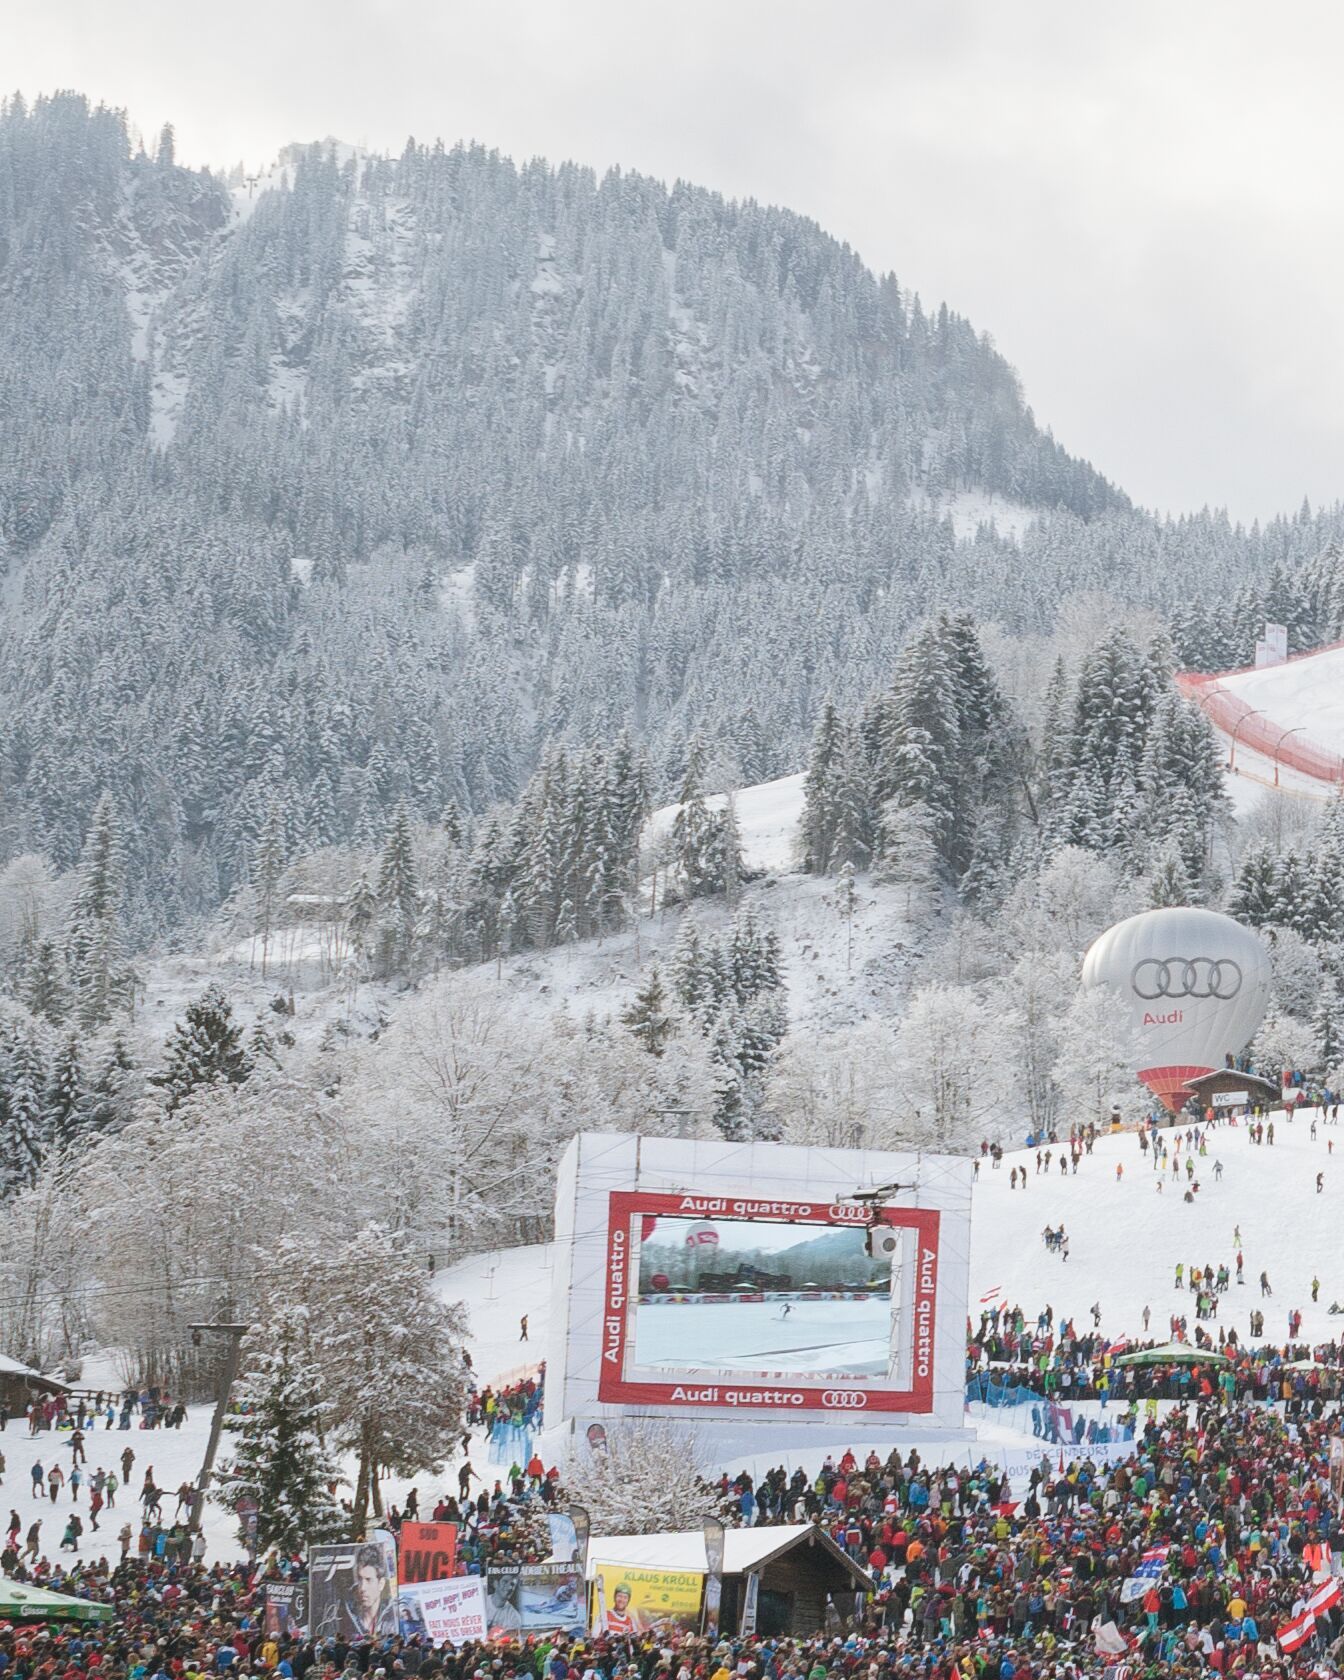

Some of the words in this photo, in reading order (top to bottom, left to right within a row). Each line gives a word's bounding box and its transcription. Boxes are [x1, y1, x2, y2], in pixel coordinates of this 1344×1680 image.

[1143, 1010, 1183, 1025] Audi
[1215, 1093, 1230, 1102] WC
[679, 1196, 727, 1211] Audi
[733, 1201, 812, 1216] quattro
[610, 1230, 626, 1310] quattro
[922, 1248, 936, 1295] Audi
[604, 1317, 621, 1363] Audi
[917, 1300, 933, 1377] quattro
[671, 1387, 719, 1402] Audi
[725, 1391, 804, 1405] quattro
[404, 1550, 449, 1583] WC
[624, 1571, 659, 1583] KLAUS
[662, 1573, 698, 1586] KRÖLL
